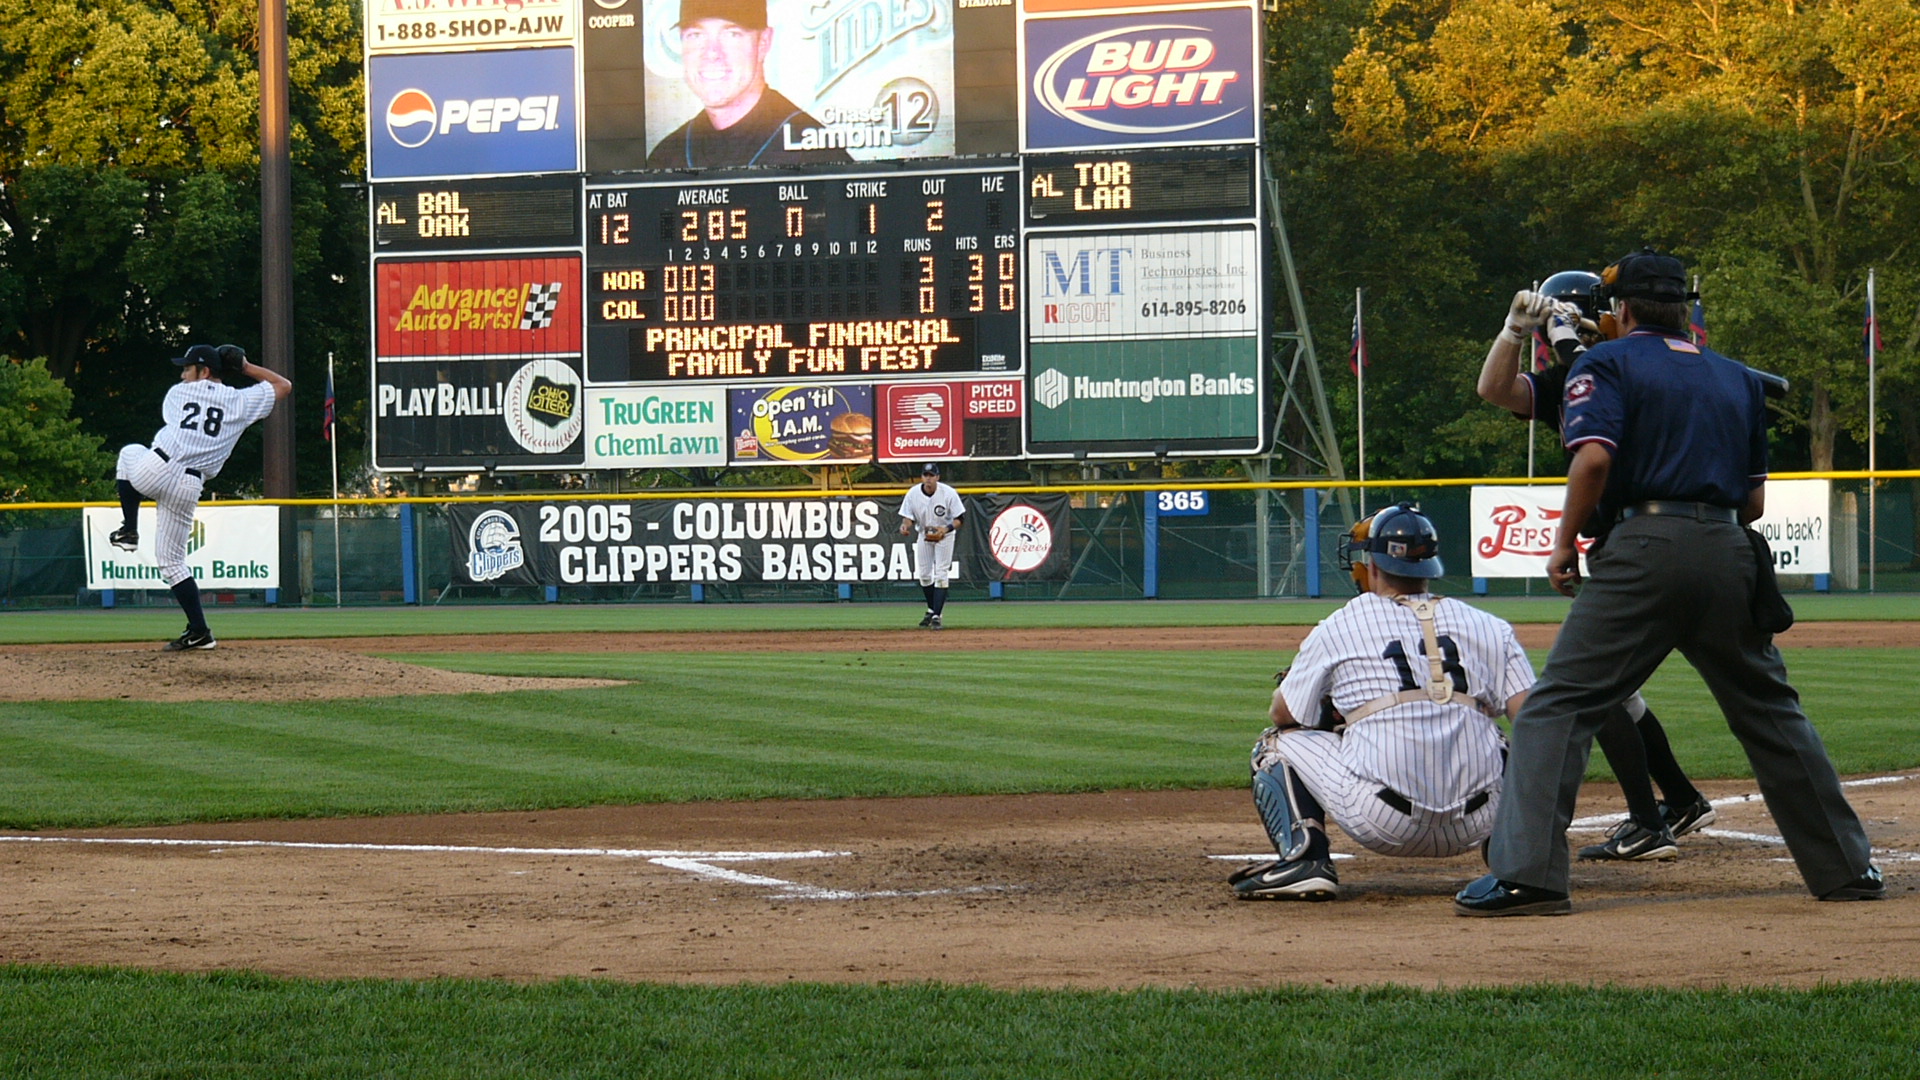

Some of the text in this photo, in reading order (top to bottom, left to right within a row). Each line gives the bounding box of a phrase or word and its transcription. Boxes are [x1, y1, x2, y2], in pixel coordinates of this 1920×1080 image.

[378, 16, 564, 40] 1-888-SHOP-AJW
[589, 15, 635, 28] COOPER
[1086, 38, 1216, 76] BUD
[1063, 71, 1239, 110] LIGHT
[440, 96, 558, 134] PEPSI
[822, 106, 882, 124] Chase
[880, 90, 934, 134] 12
[783, 122, 892, 150] Lambin
[981, 177, 1004, 192] H/E
[1032, 173, 1064, 197] AL
[1074, 161, 1131, 186] TOR
[677, 189, 730, 205] AVERAGE
[778, 185, 808, 200] BALL
[846, 182, 887, 198] STRIKE
[922, 179, 946, 195] OUT
[1074, 186, 1131, 211] LAA
[418, 192, 469, 214] BAL
[589, 193, 628, 208] AT BAT
[377, 202, 406, 224] AL
[926, 201, 943, 232] 2
[418, 215, 470, 237] OAK
[601, 214, 630, 244] 12
[685, 248, 692, 261] 2
[703, 247, 710, 260] 3
[721, 246, 728, 259] 4
[740, 246, 747, 258] 5
[758, 245, 765, 258] 6
[776, 244, 783, 257] 7
[794, 243, 802, 256] 8
[811, 243, 819, 255] 9
[829, 242, 840, 255] 10
[850, 241, 857, 254] 11
[866, 241, 877, 254] 12
[904, 236, 1015, 252] RUNS HITS ERS
[1141, 248, 1191, 259] Business
[602, 270, 645, 290] NOR
[919, 256, 934, 283] 3
[1040, 248, 1133, 298] MT
[1141, 263, 1248, 277] Technologies, Inc.
[407, 284, 518, 310] Advance
[1141, 300, 1246, 317] 614-895-8206
[453, 309, 512, 331] Parts
[602, 300, 645, 320] COL
[1044, 303, 1110, 324] RICOH
[646, 318, 960, 352] PRINCIPAL FINANCIAL
[668, 344, 938, 376] FAMILY FUN FEST
[538, 385, 569, 402] OHIO
[971, 384, 1013, 398] PITCH
[1074, 372, 1255, 403] Huntington Banks
[753, 387, 834, 421] Open 'til
[969, 399, 1016, 413] SPEED
[180, 402, 224, 437] 28
[783, 415, 823, 437] A.M.
[594, 433, 720, 456] ChemLawn
[894, 436, 947, 449] Speedway
[1158, 491, 1204, 510] 365
[539, 501, 880, 542] 2005 - COLUMBUS
[1786, 516, 1822, 540] back?
[990, 526, 1048, 555] Yankees
[101, 560, 269, 584] Huntinn Banks
[473, 550, 520, 576] Clippers
[559, 543, 960, 583] CLIPPERS BASEBA
[1383, 635, 1469, 694] 13
